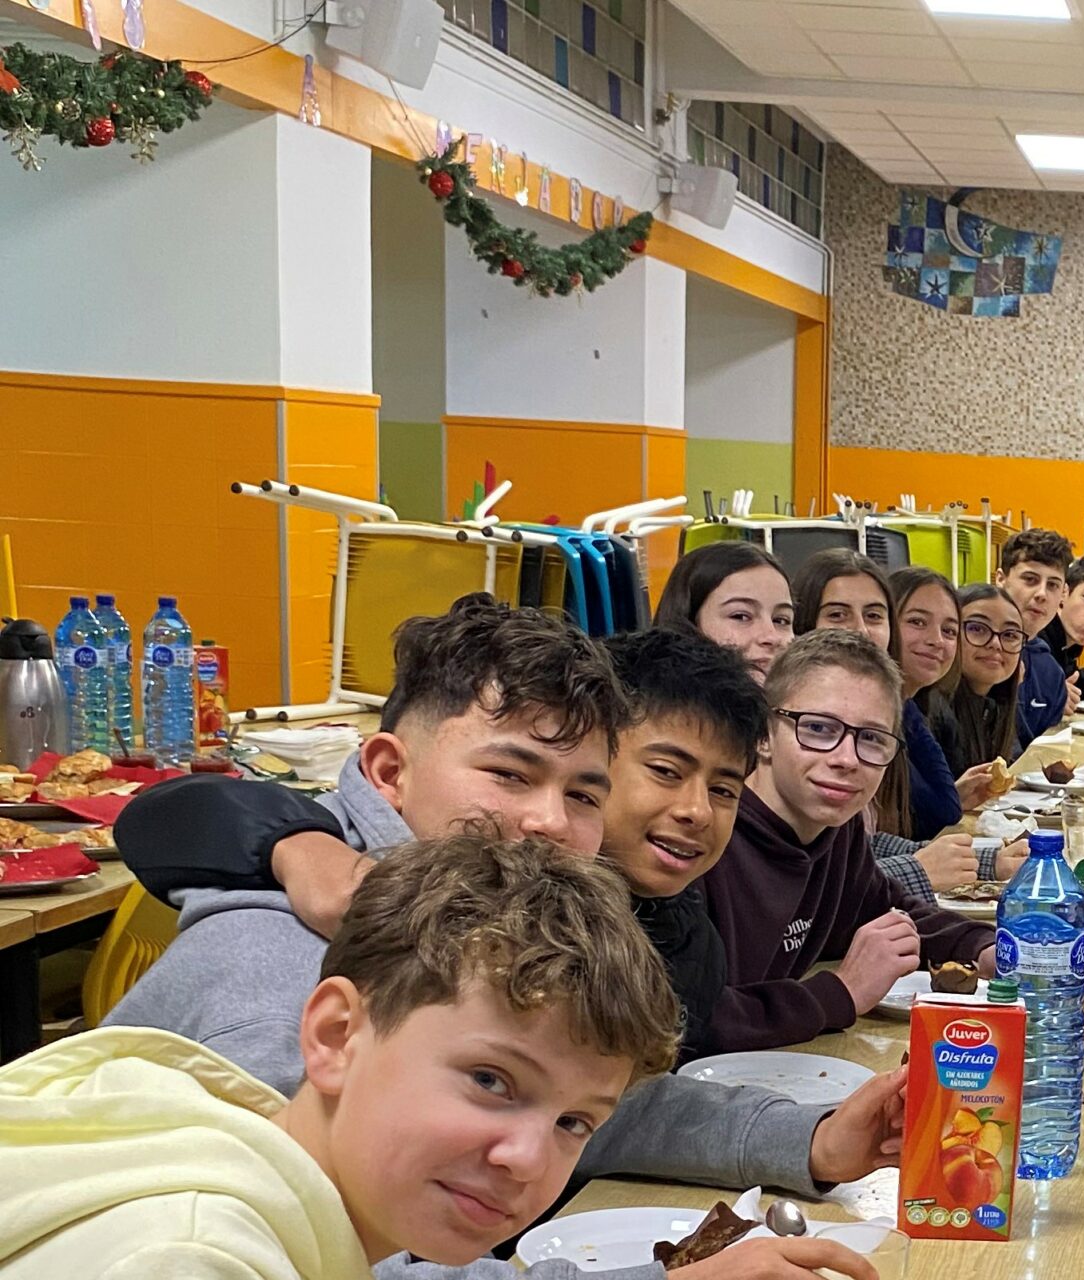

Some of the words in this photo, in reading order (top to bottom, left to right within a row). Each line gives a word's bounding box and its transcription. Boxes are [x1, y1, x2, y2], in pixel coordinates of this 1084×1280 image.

[947, 1027, 988, 1040] Juver
[938, 1050, 995, 1065] Disfruta
[976, 1206, 983, 1218] 1
